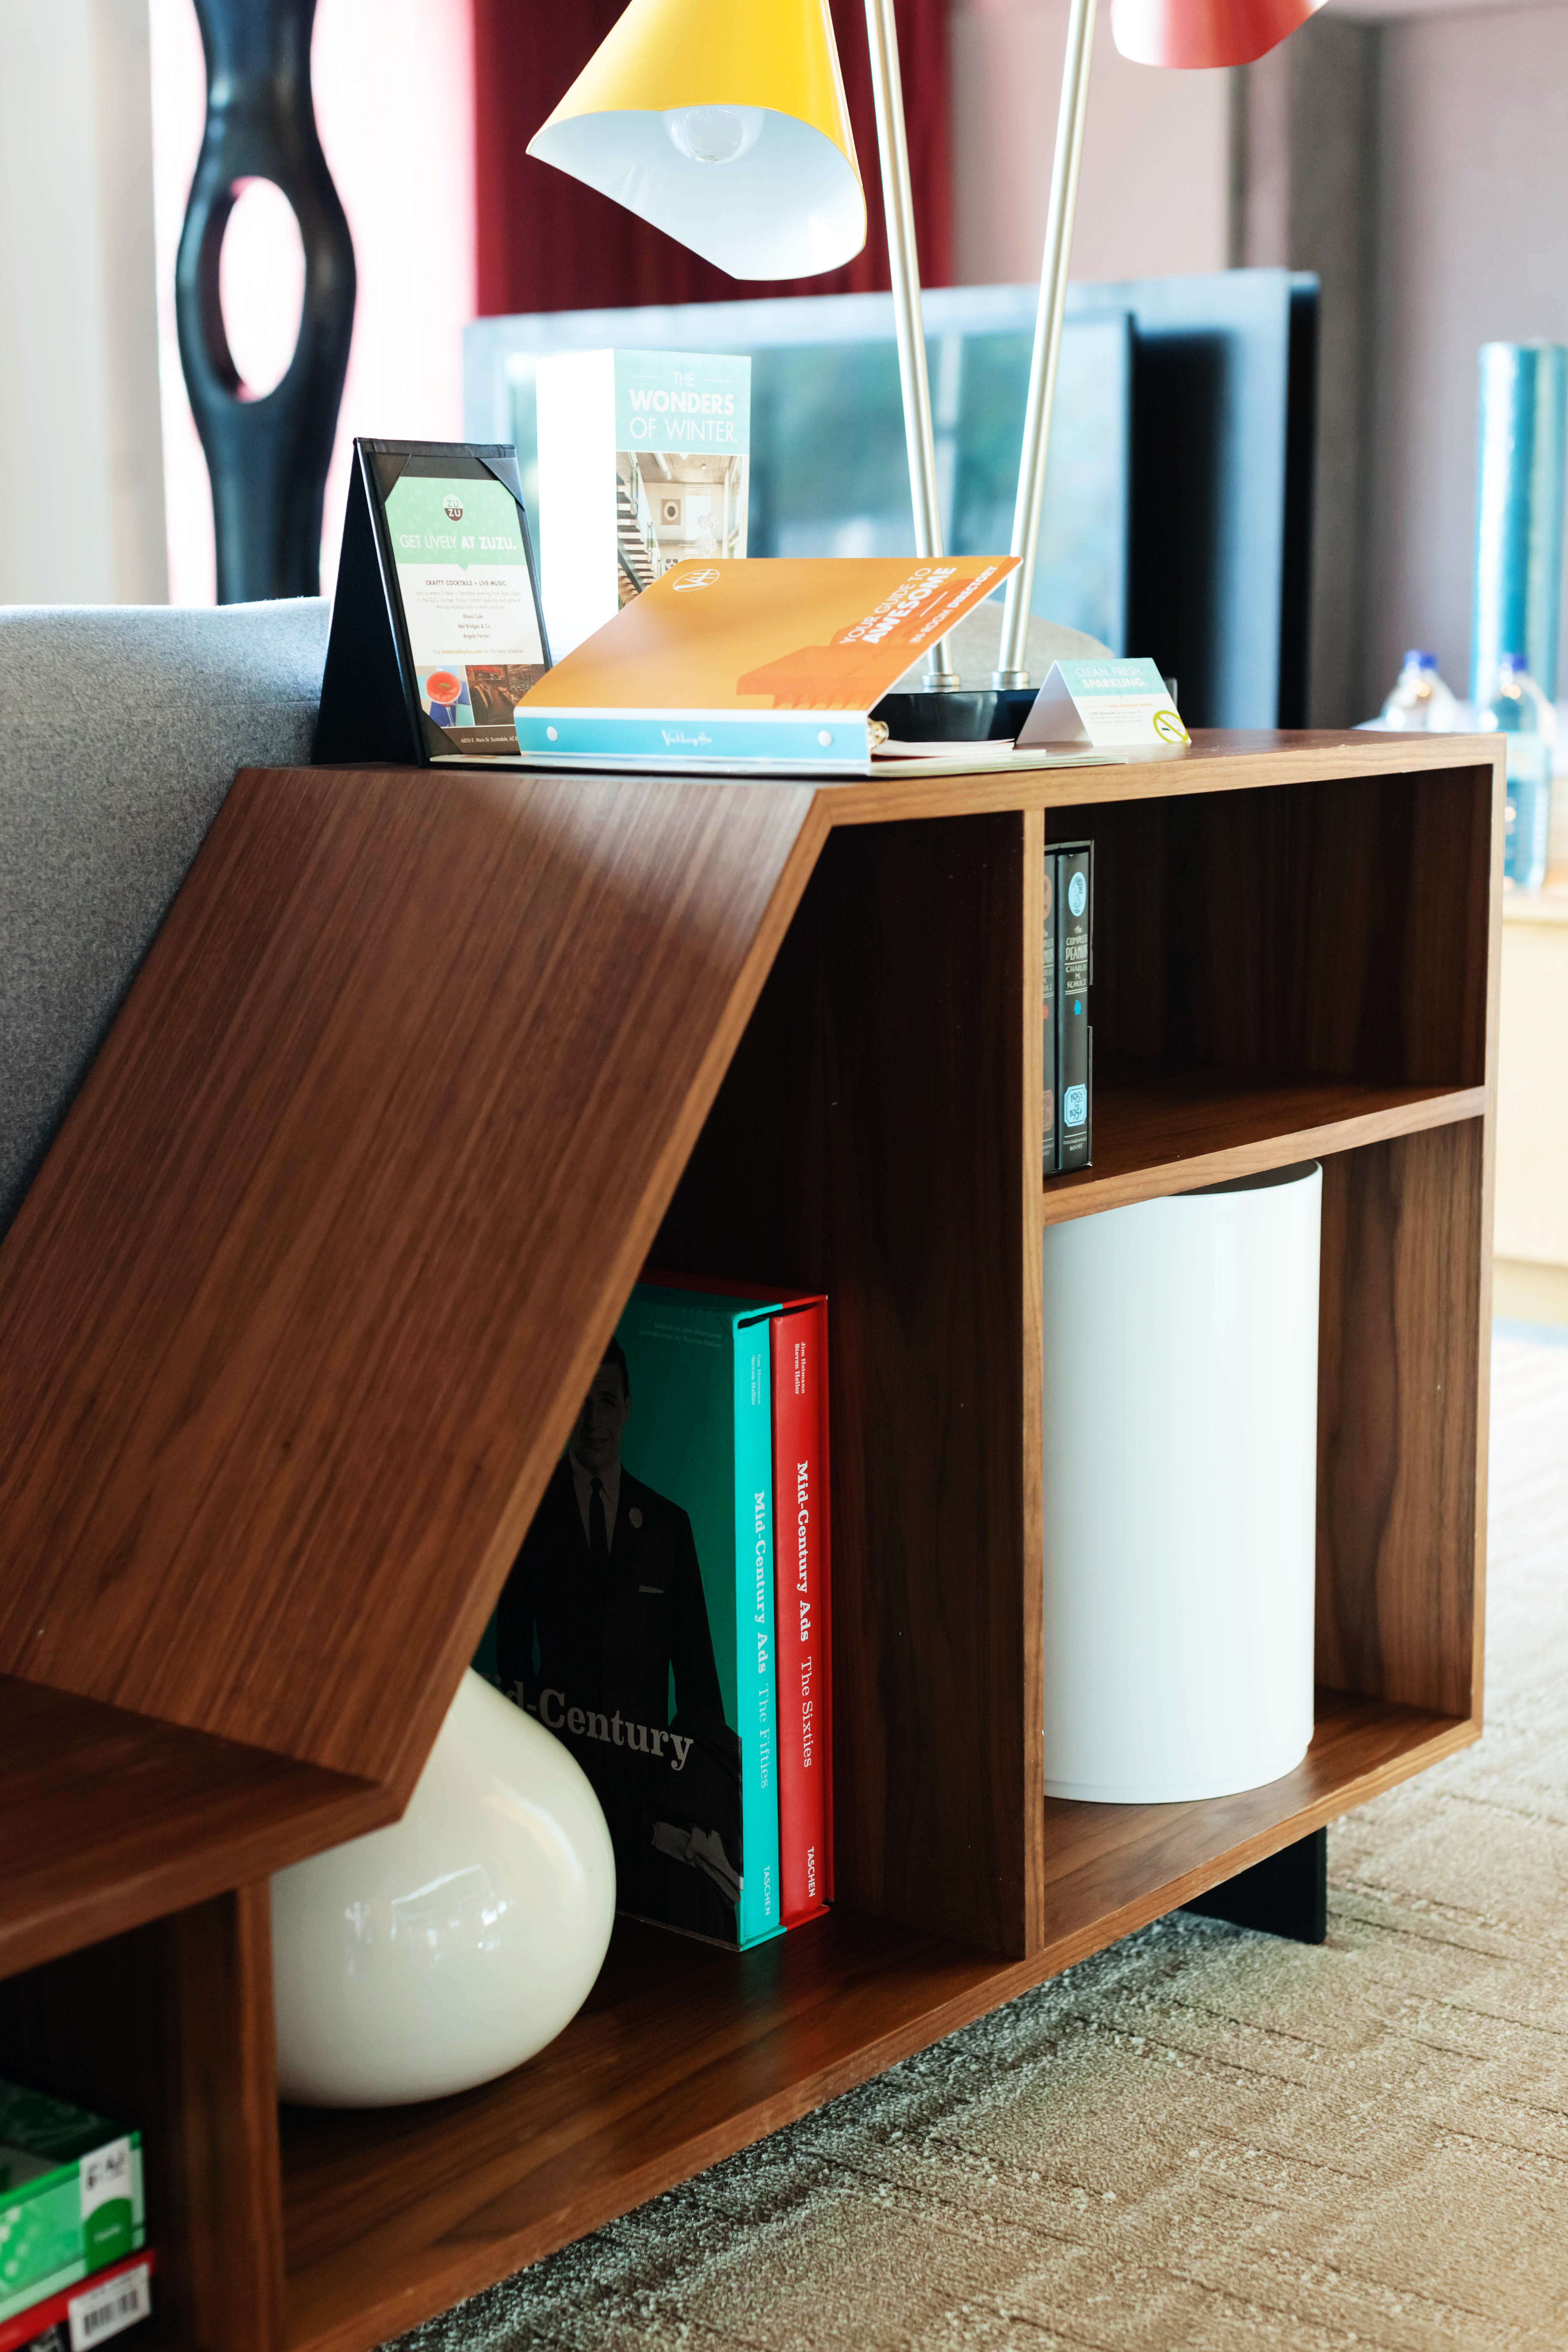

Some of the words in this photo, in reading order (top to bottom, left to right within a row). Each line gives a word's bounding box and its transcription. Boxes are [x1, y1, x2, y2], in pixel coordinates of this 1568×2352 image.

[673, 372, 694, 387] THE
[629, 389, 735, 415] WONDERS
[629, 417, 657, 439] OF
[665, 418, 738, 443] WINTER.
[447, 508, 461, 517] ZU
[400, 534, 420, 549] GET
[424, 535, 456, 549] LIVELY
[461, 536, 475, 549] AT
[478, 536, 516, 550] ZUZU.
[839, 616, 881, 644] YOUR
[874, 584, 916, 614] GUIDE
[907, 567, 931, 582] TO
[862, 567, 957, 644] AWESOME
[946, 566, 998, 609] DIRECTORY
[1082, 677, 1148, 689] SPARKLING.
[797, 1460, 809, 1593] Mid-Century
[755, 1490, 766, 1624] Mid-Century
[799, 1600, 811, 1642] Ads
[758, 1632, 768, 1674] Ads
[802, 1656, 812, 1696] The
[486, 1673, 694, 1771] d-Century
[759, 1683, 769, 1723] The
[802, 1701, 813, 1768] Sixties
[760, 1728, 770, 1789] Fifties
